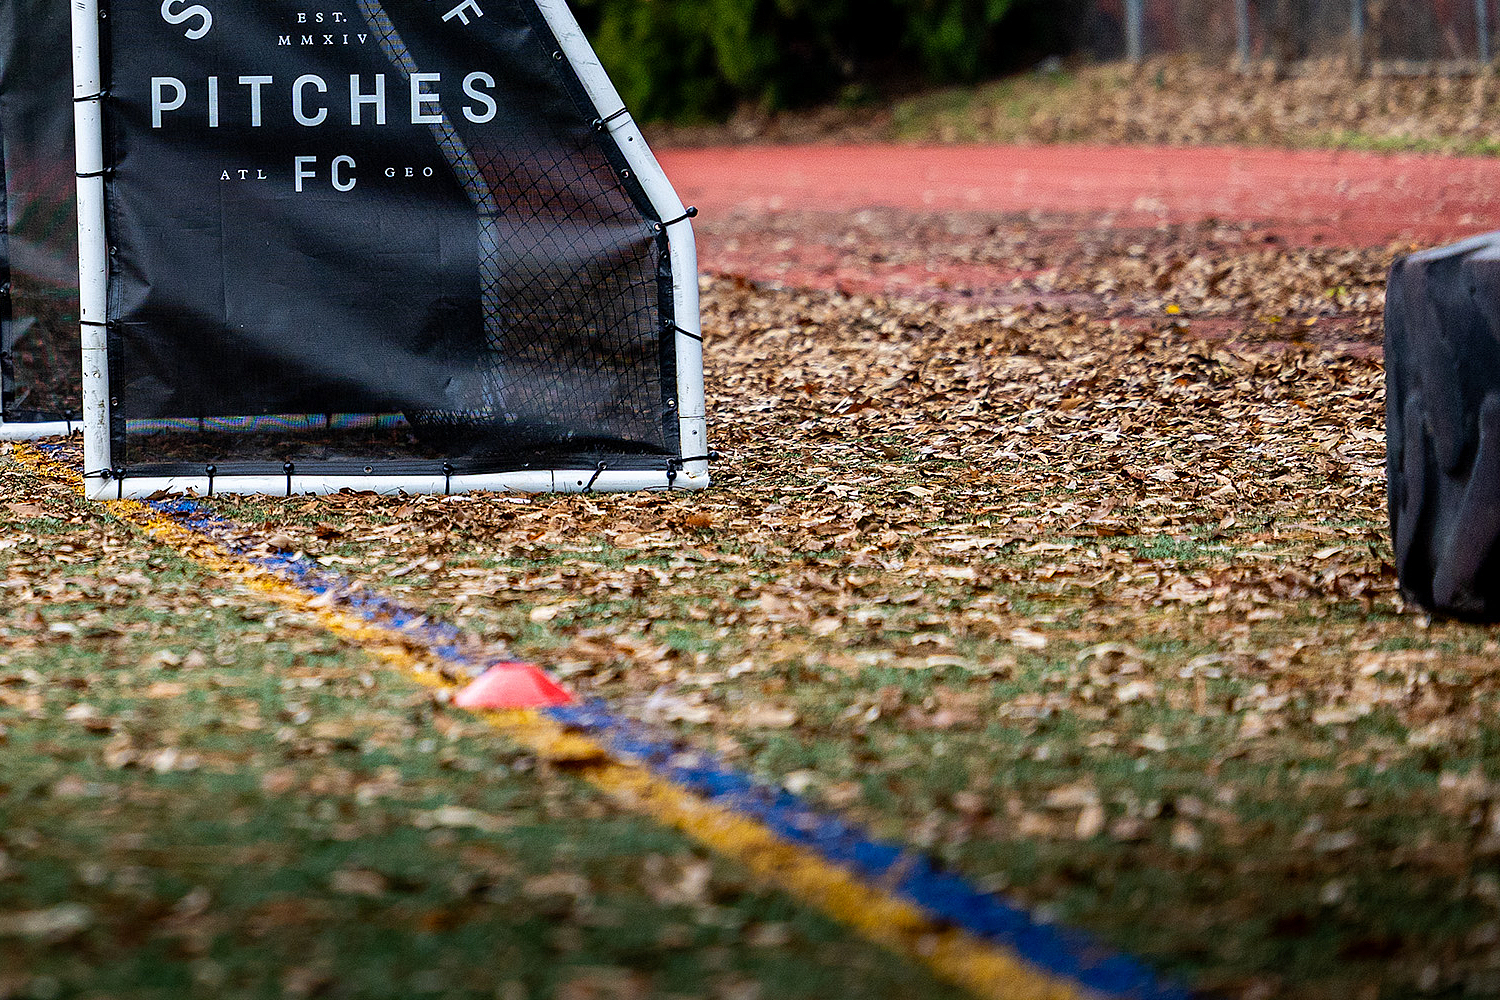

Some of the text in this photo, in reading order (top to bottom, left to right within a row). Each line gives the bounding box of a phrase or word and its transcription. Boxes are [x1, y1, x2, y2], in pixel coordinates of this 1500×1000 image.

[297, 12, 348, 24] EST.
[278, 33, 369, 46] MMXIV
[150, 71, 498, 129] PITCHES
[220, 154, 434, 193] ATL FC GEO
